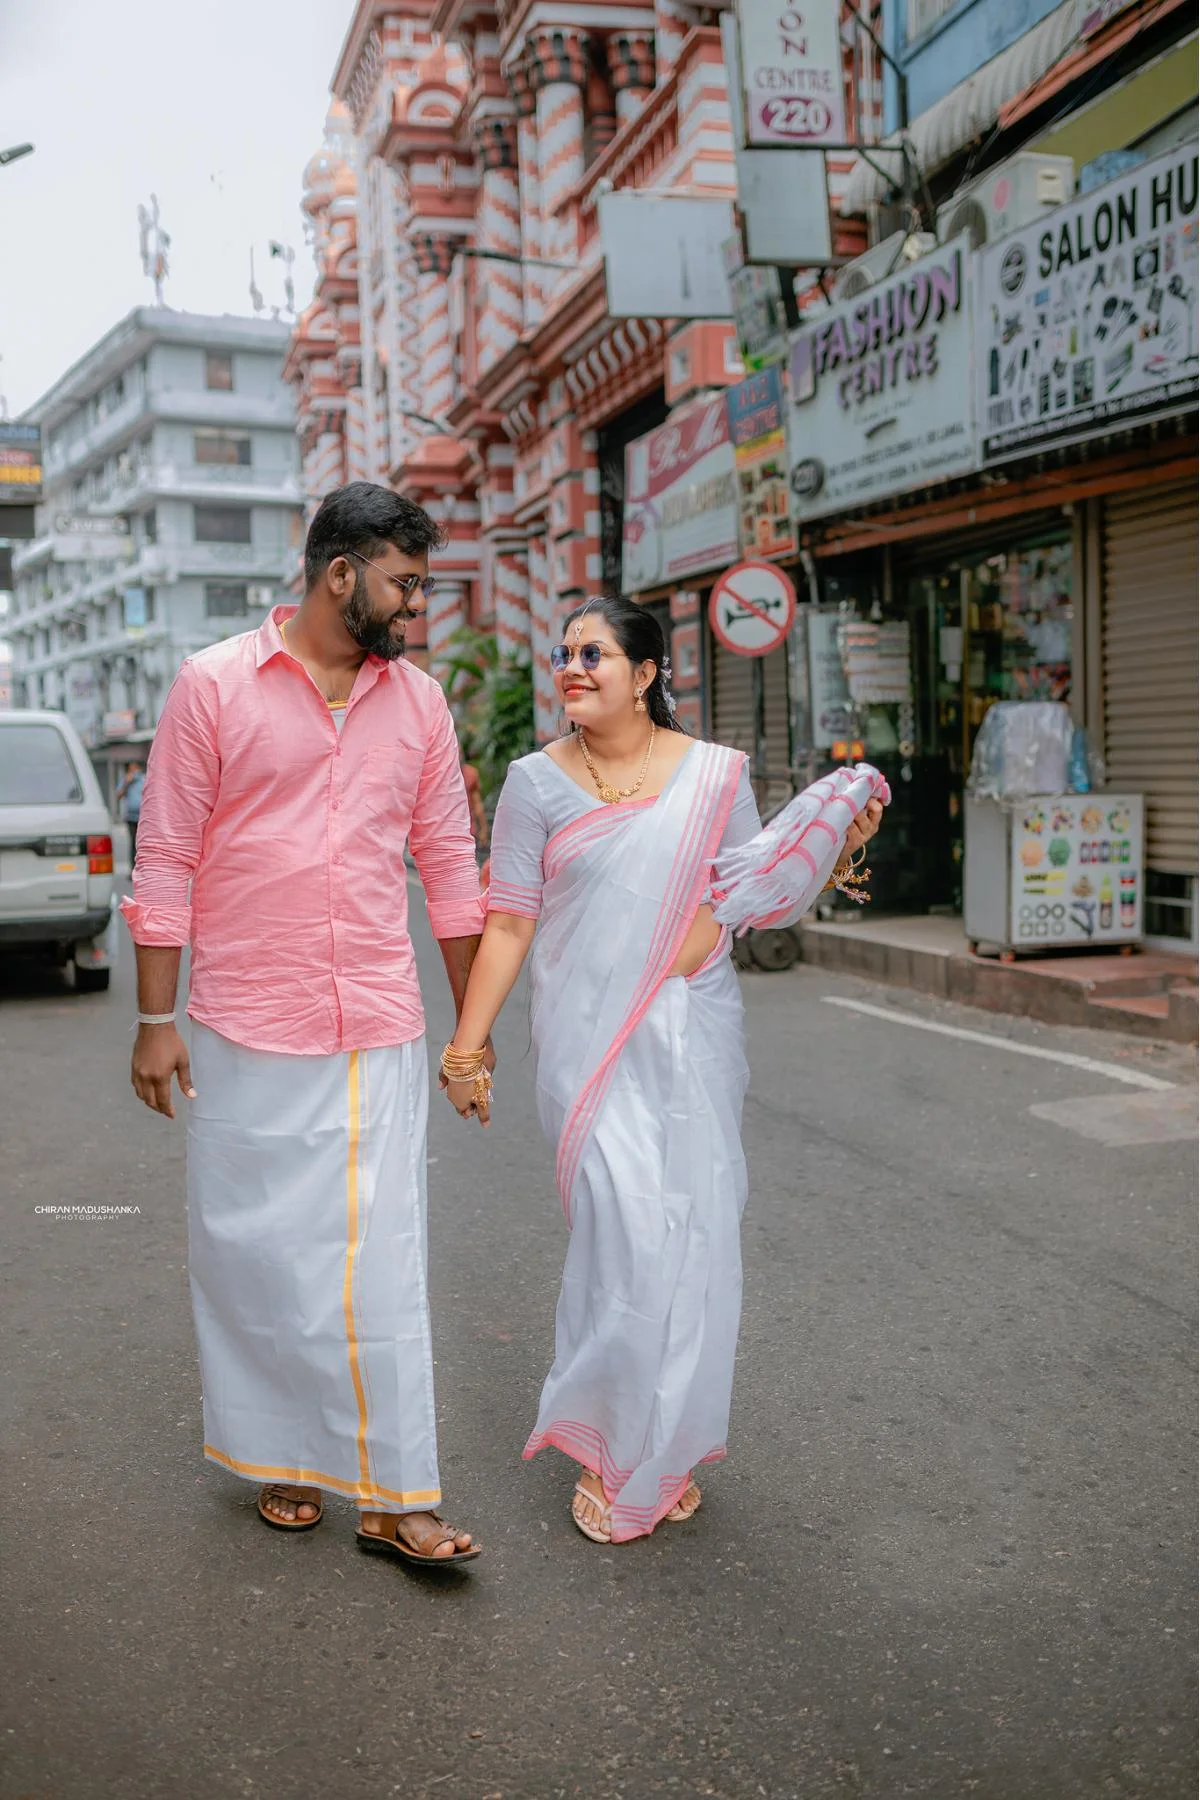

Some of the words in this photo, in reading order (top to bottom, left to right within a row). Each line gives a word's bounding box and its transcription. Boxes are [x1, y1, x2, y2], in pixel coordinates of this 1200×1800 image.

[779, 0, 807, 56] ON
[754, 66, 833, 92] CENTRE
[768, 97, 827, 133] 220
[1039, 187, 1137, 278] SALON
[815, 249, 961, 376] FASHION
[836, 333, 939, 411] CENTRE
